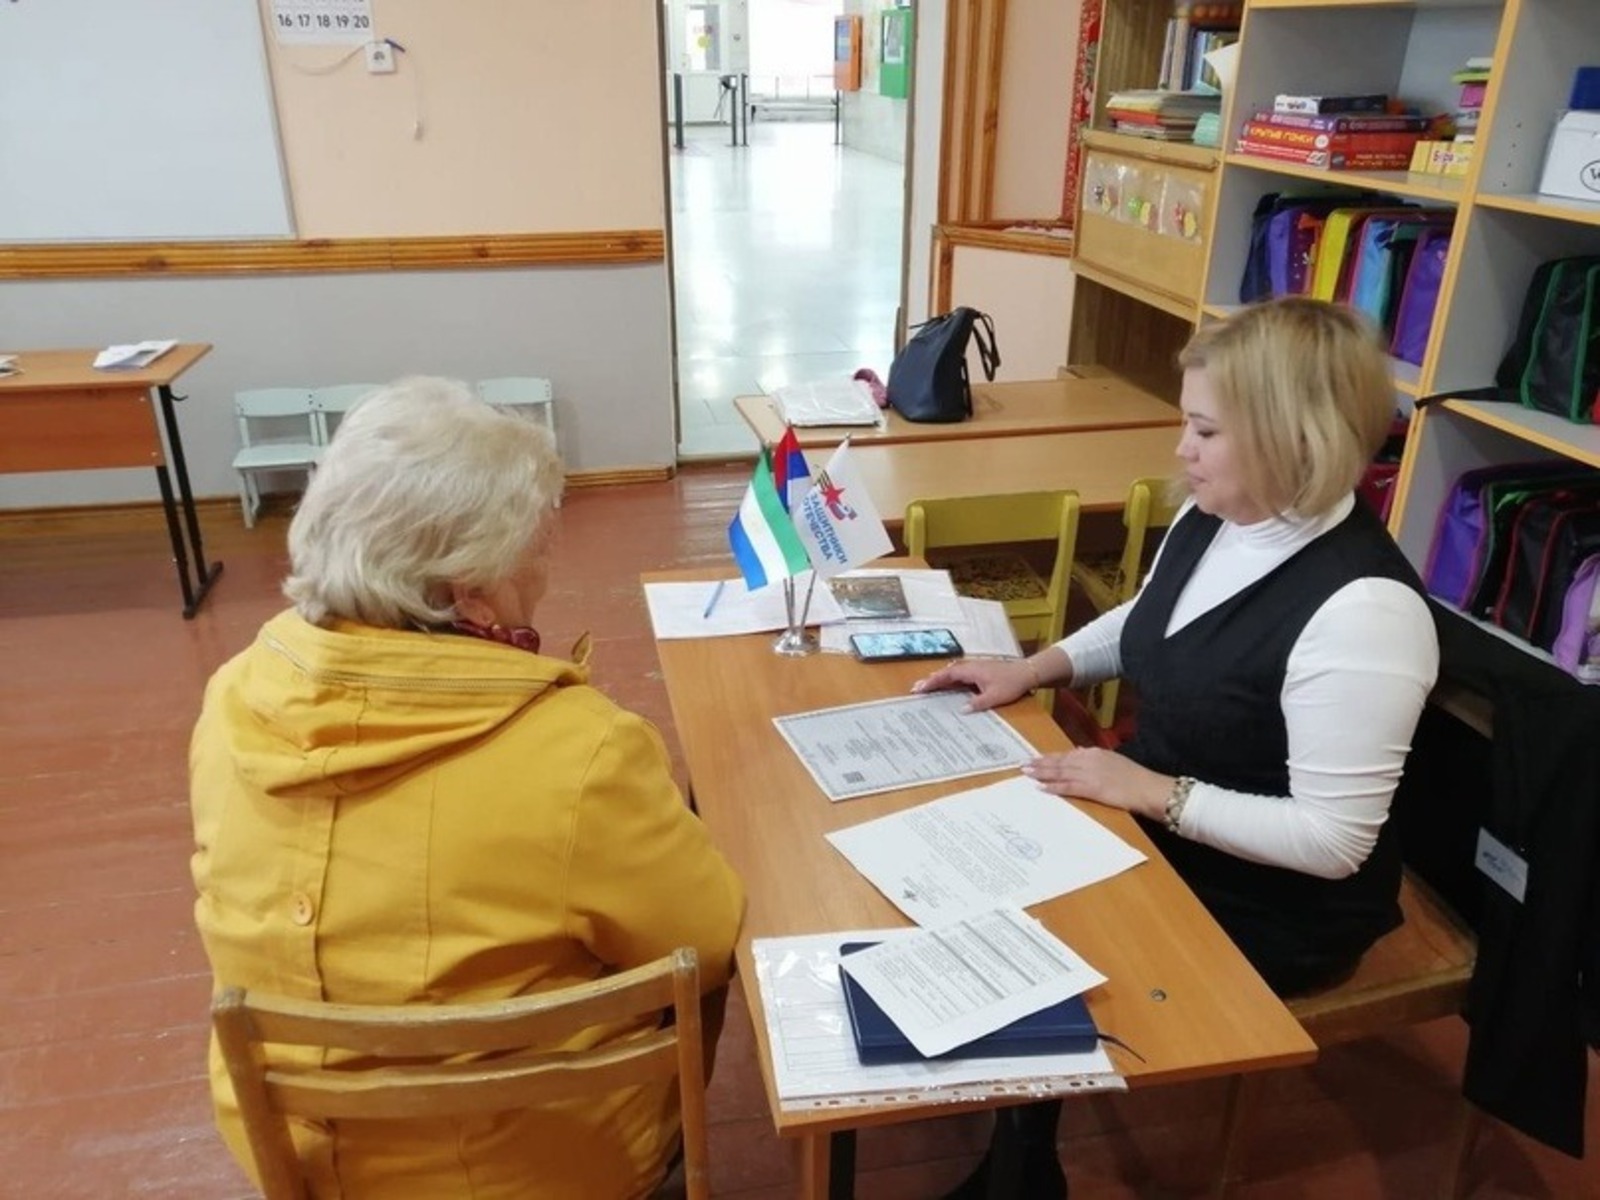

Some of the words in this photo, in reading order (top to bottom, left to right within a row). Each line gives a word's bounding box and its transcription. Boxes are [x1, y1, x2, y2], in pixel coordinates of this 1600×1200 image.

[277, 13, 293, 27] 16
[297, 13, 311, 27] 17
[316, 14, 331, 28] 18
[335, 14, 350, 28] 19
[352, 15, 370, 29] 20
[803, 497, 833, 561] ОТЕЧЕСТВА
[810, 493, 848, 565] ЗАЩИТНИКИ
